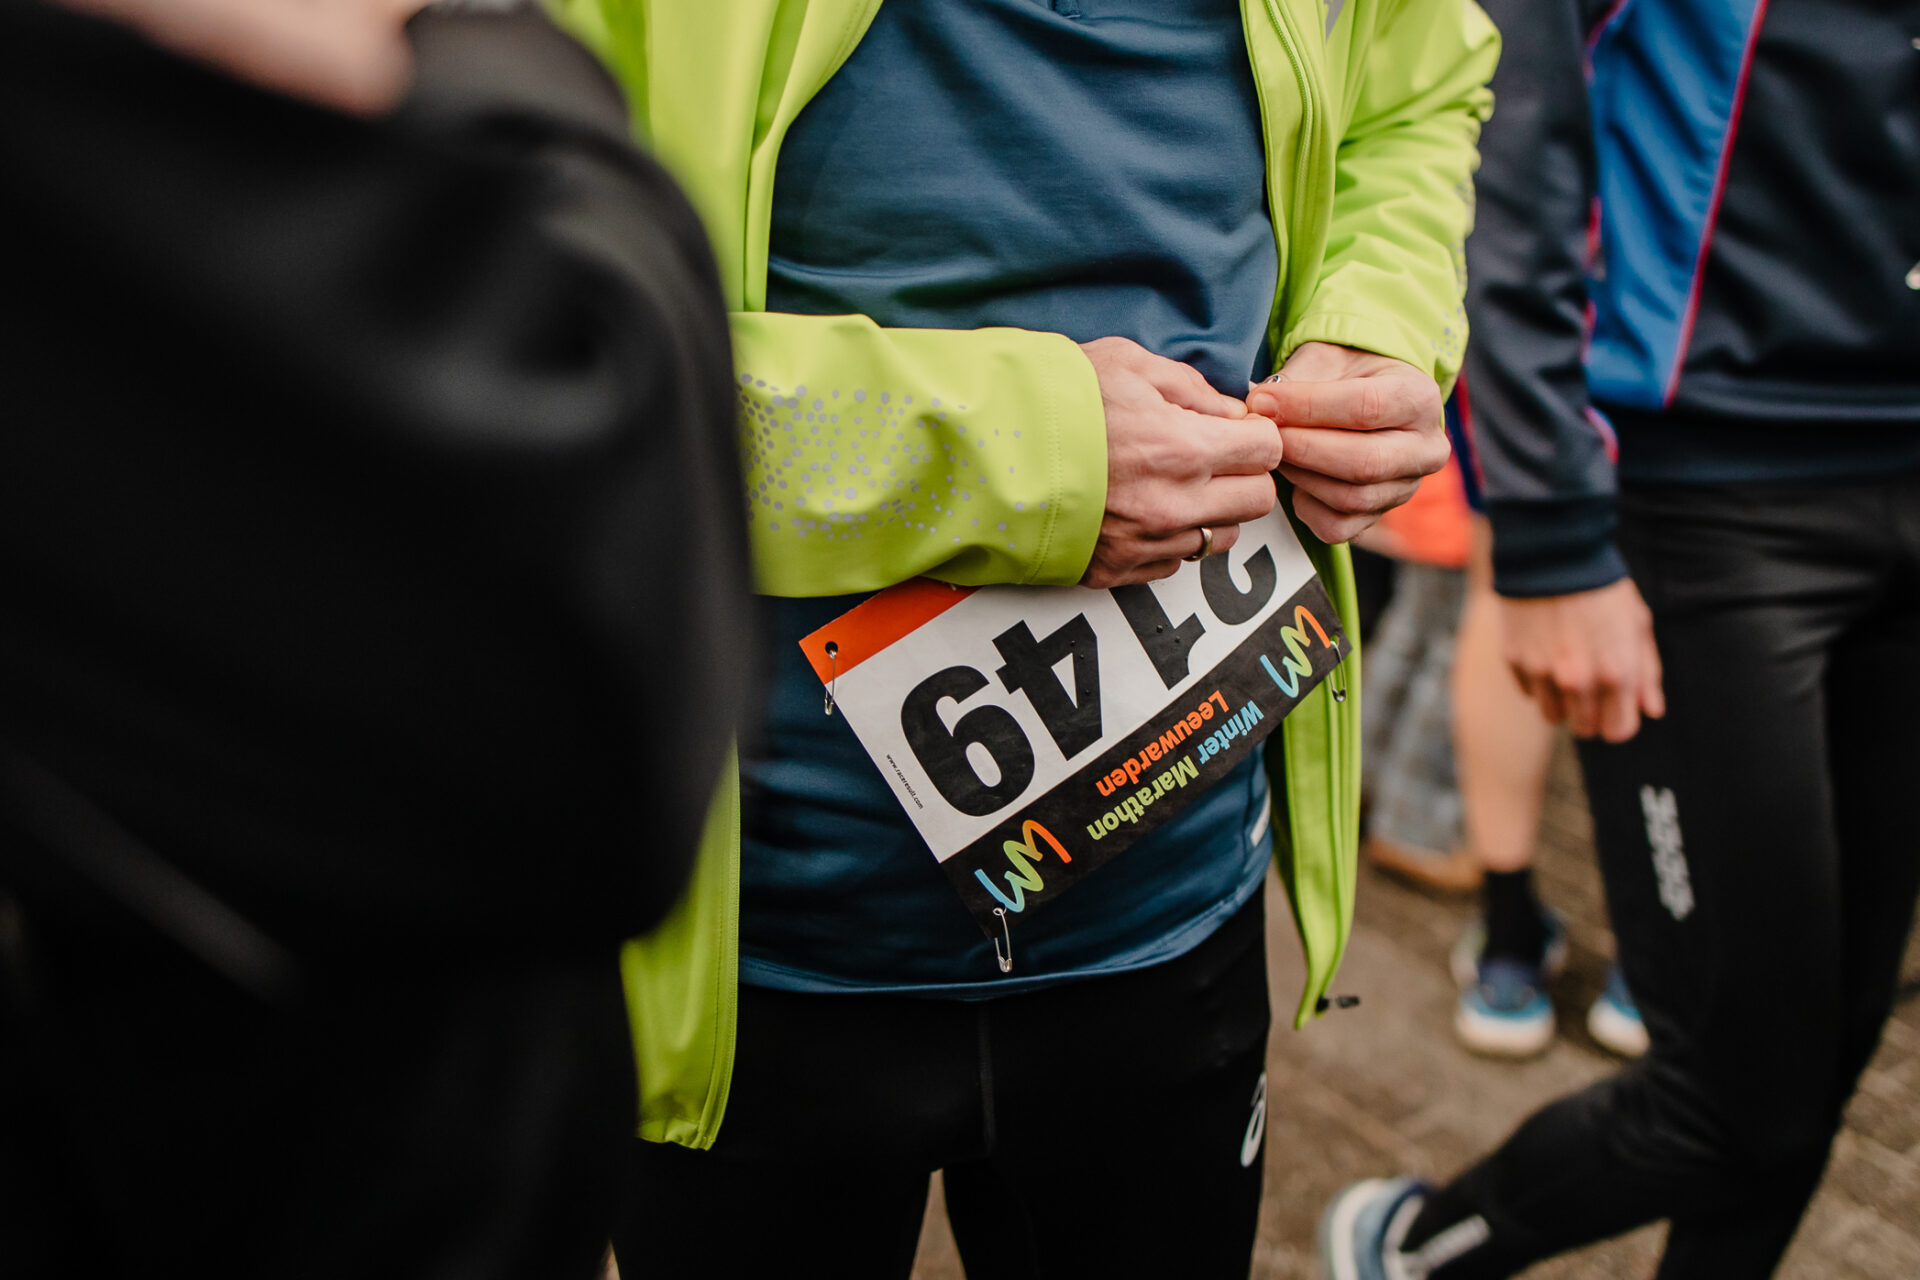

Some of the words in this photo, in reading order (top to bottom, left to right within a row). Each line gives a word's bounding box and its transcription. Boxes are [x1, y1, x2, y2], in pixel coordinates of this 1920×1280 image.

[901, 544, 1277, 817] 2149
[1096, 690, 1229, 796] Leeuwarden
[1198, 700, 1264, 765] Winter
[1086, 755, 1199, 841] Marathon
